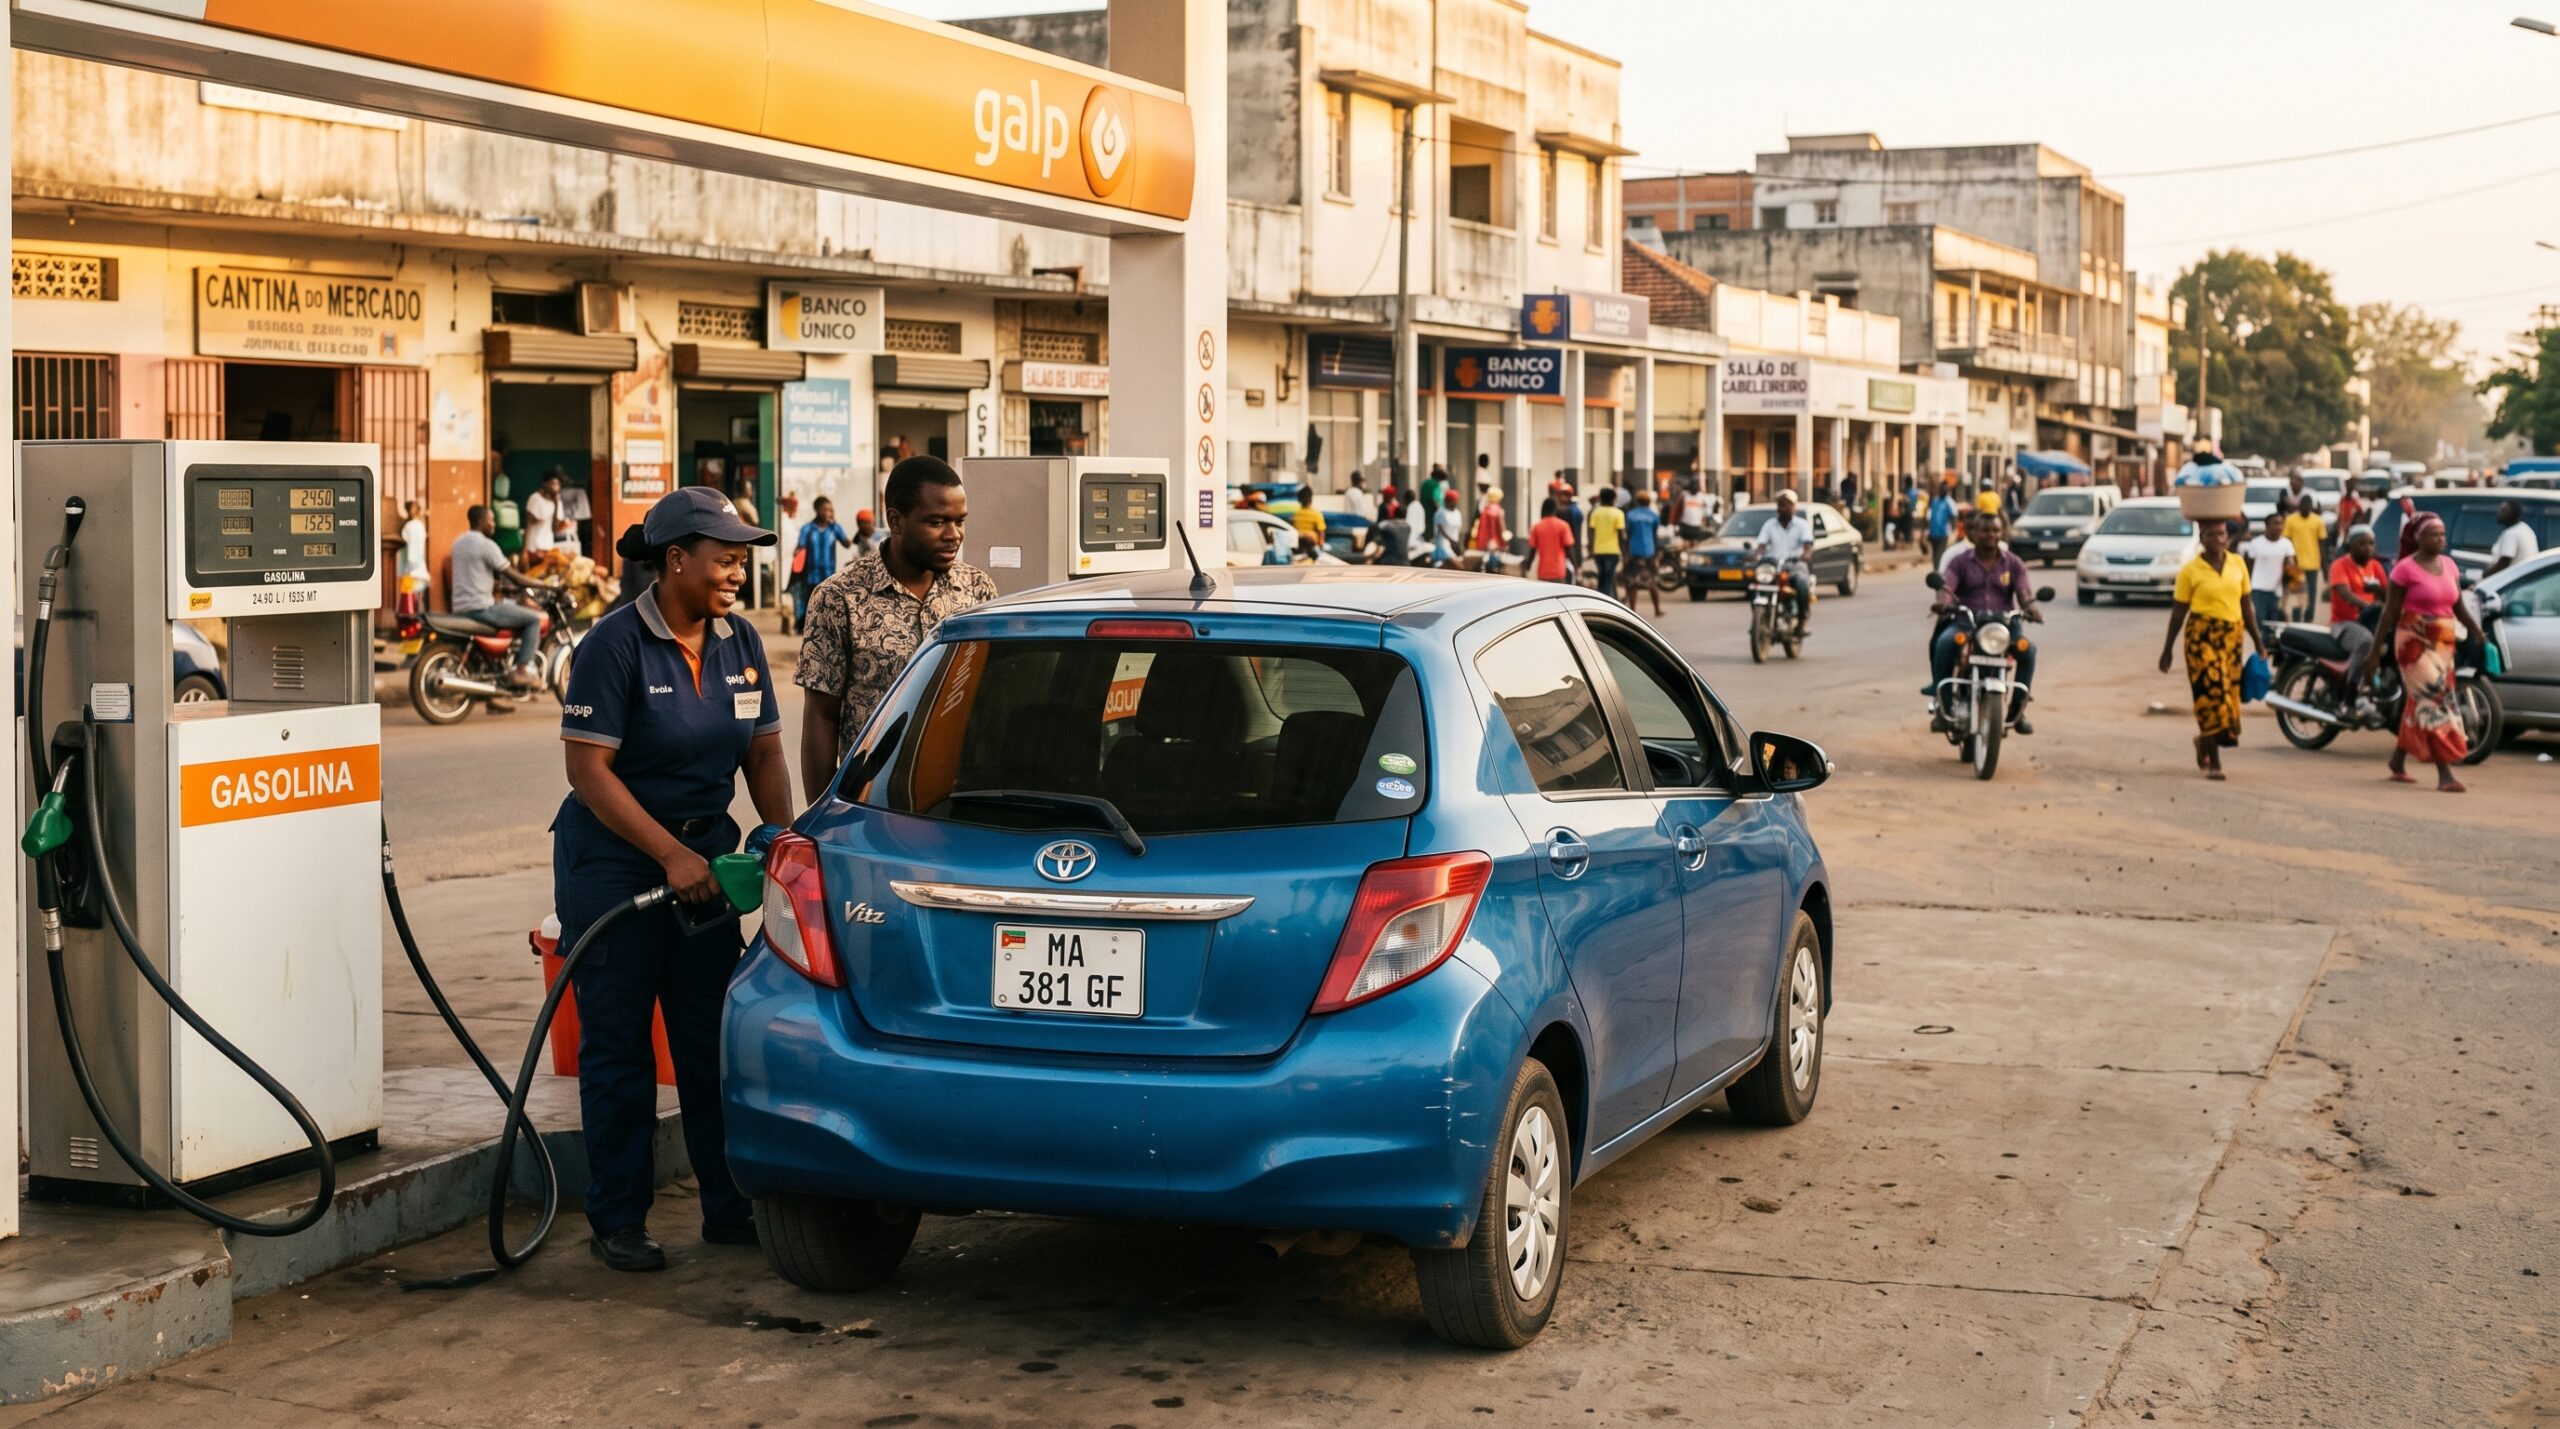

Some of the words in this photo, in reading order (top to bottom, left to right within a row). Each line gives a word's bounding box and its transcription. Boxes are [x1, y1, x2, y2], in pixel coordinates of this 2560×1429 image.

[974, 79, 1070, 179] galp
[206, 274, 301, 314] CANTINA
[305, 289, 323, 308] DO
[328, 283, 421, 322] MERCADO
[802, 296, 867, 317] BANCO
[801, 316, 856, 341] ÚNICO
[1487, 356, 1553, 374] BANCO
[1781, 361, 1798, 377] DE
[301, 489, 332, 507] 2450
[304, 515, 332, 532] 1525
[264, 571, 305, 582] GASOLINA
[210, 761, 354, 809] GASOLINA
[845, 901, 886, 924] Vitz
[1048, 932, 1085, 968] MA
[1018, 970, 1072, 1007] 381
[1087, 974, 1124, 1009] GF
